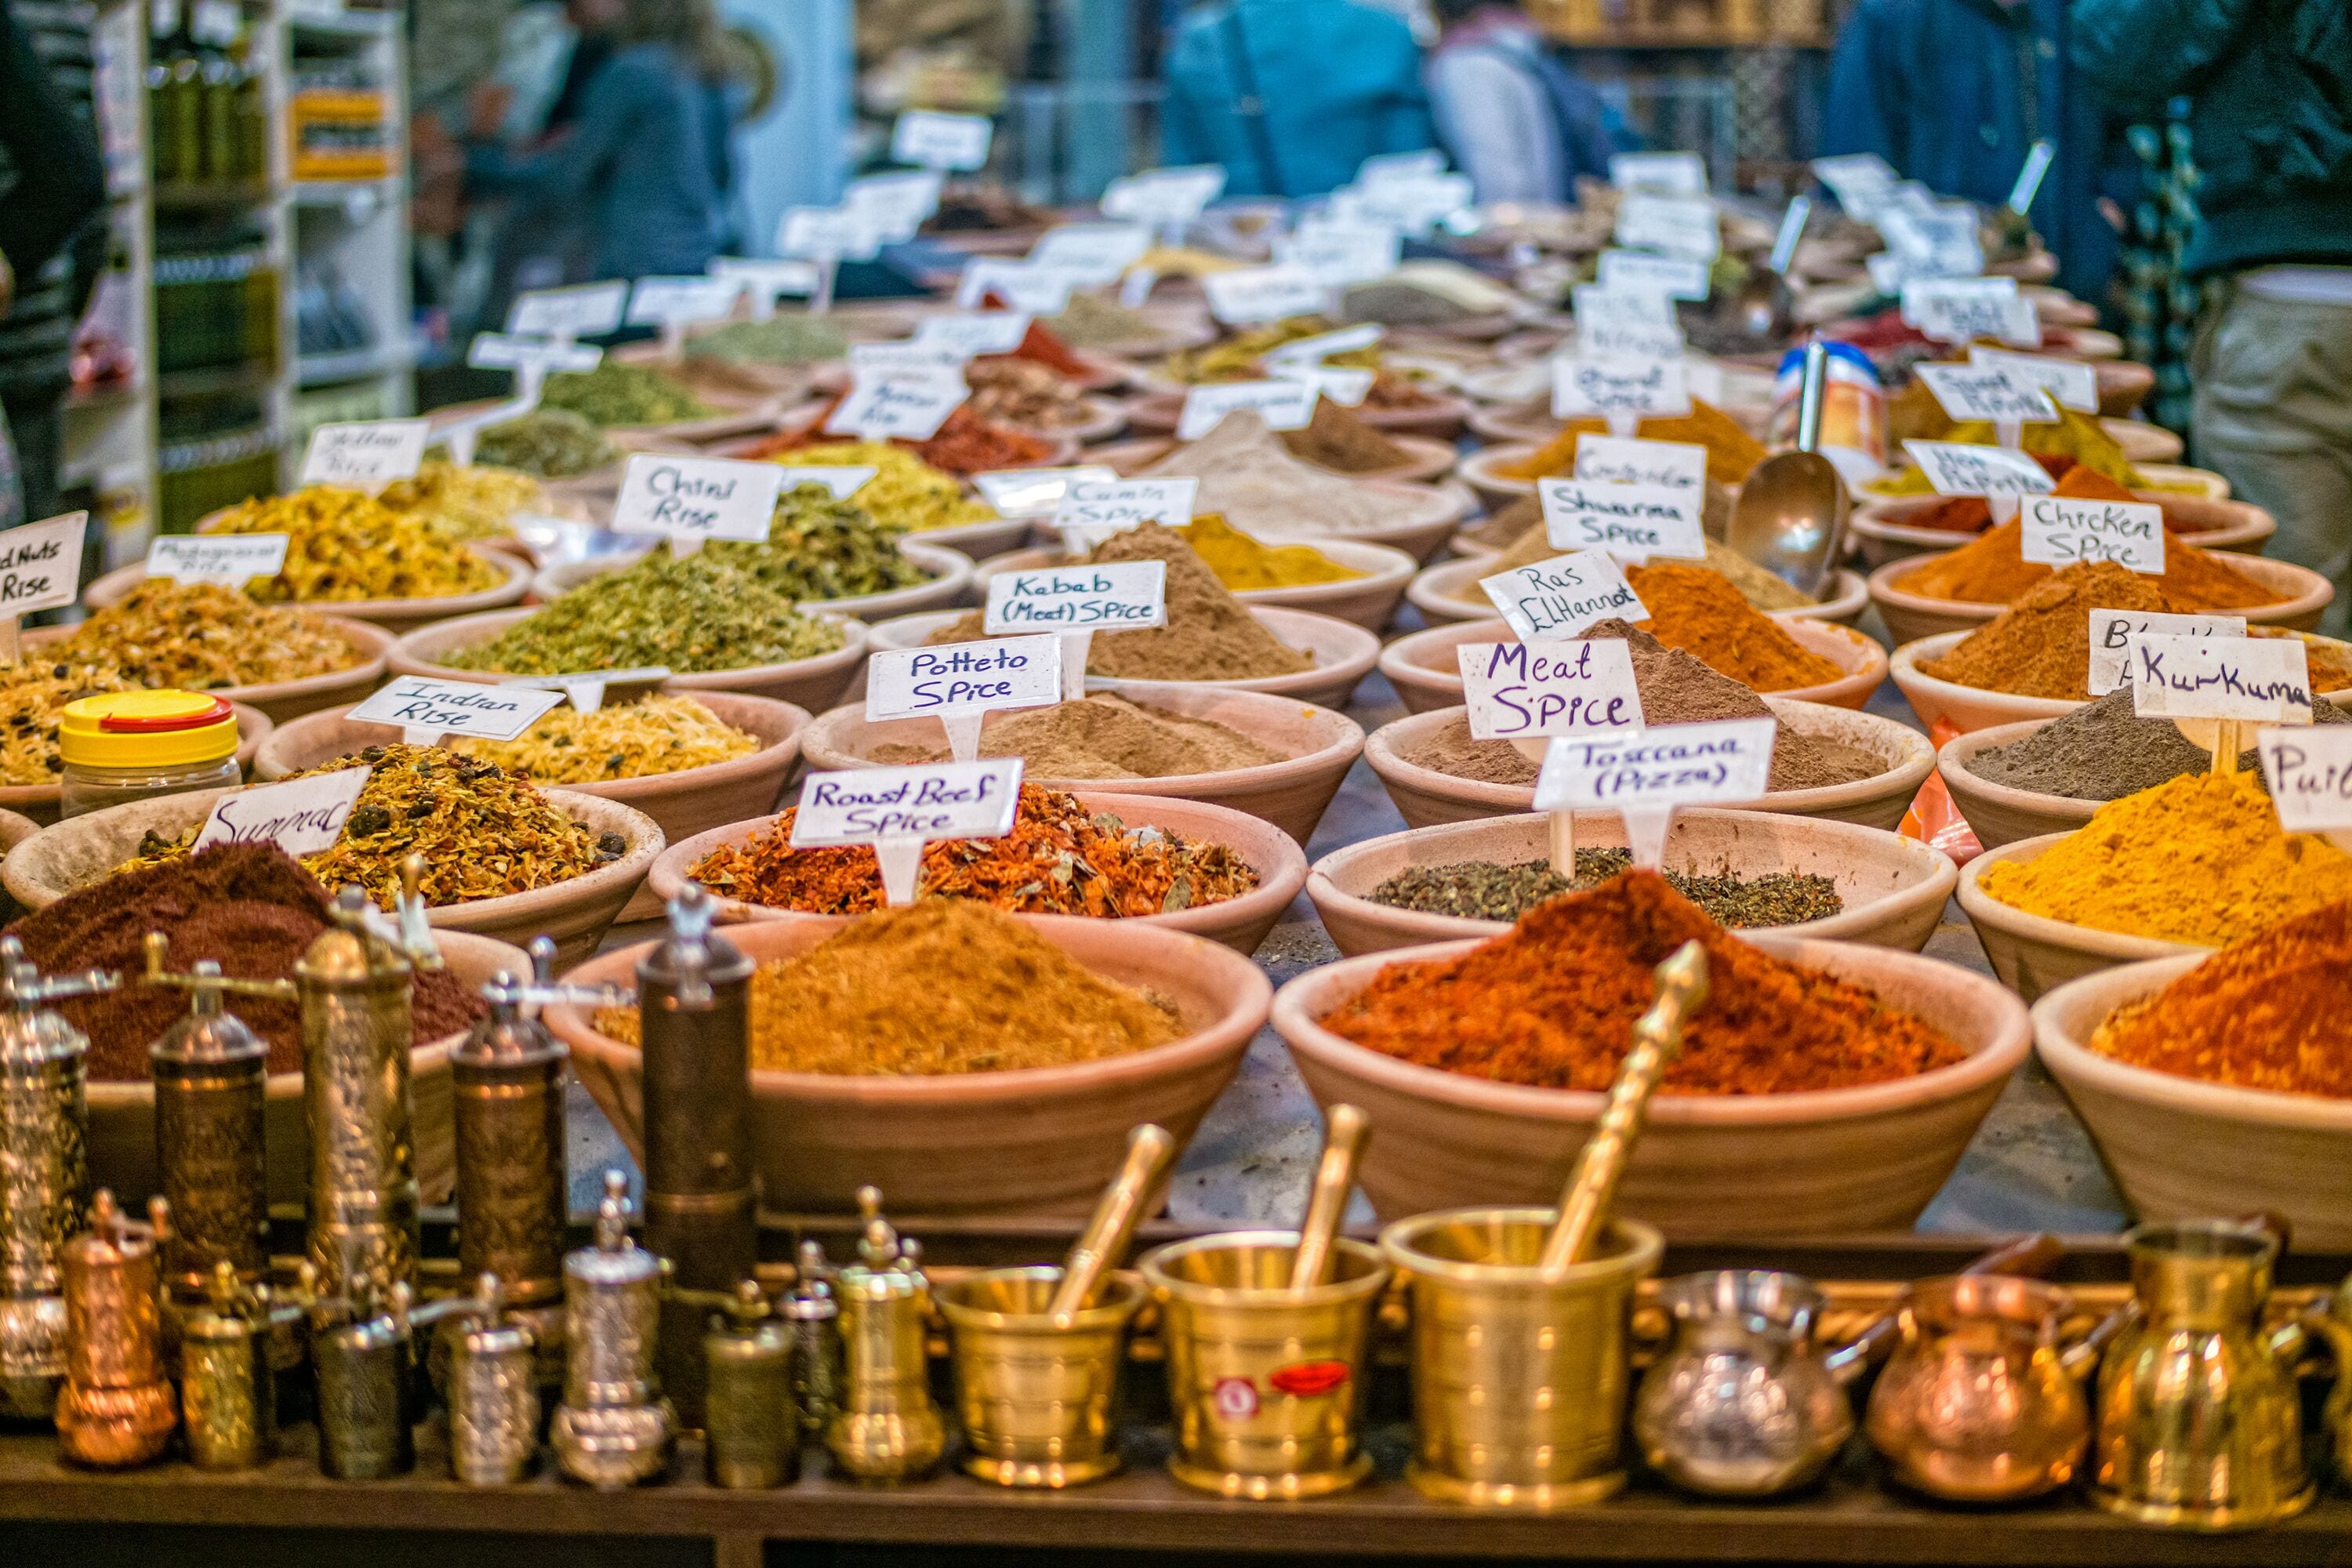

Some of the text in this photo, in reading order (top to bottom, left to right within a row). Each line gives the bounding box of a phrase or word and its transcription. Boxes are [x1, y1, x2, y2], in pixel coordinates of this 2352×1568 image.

[651, 495, 720, 529] Rise
[2, 572, 53, 603] Rise
[1014, 573, 1113, 597] Kabab
[1517, 568, 1583, 592] Ras
[911, 648, 1029, 677] Potteto
[1487, 641, 1592, 682] Meat
[395, 682, 519, 711] Indian
[393, 701, 473, 726] Rise
[813, 773, 997, 808] Roast Beef
[1593, 760, 1728, 798] (Pizza)
